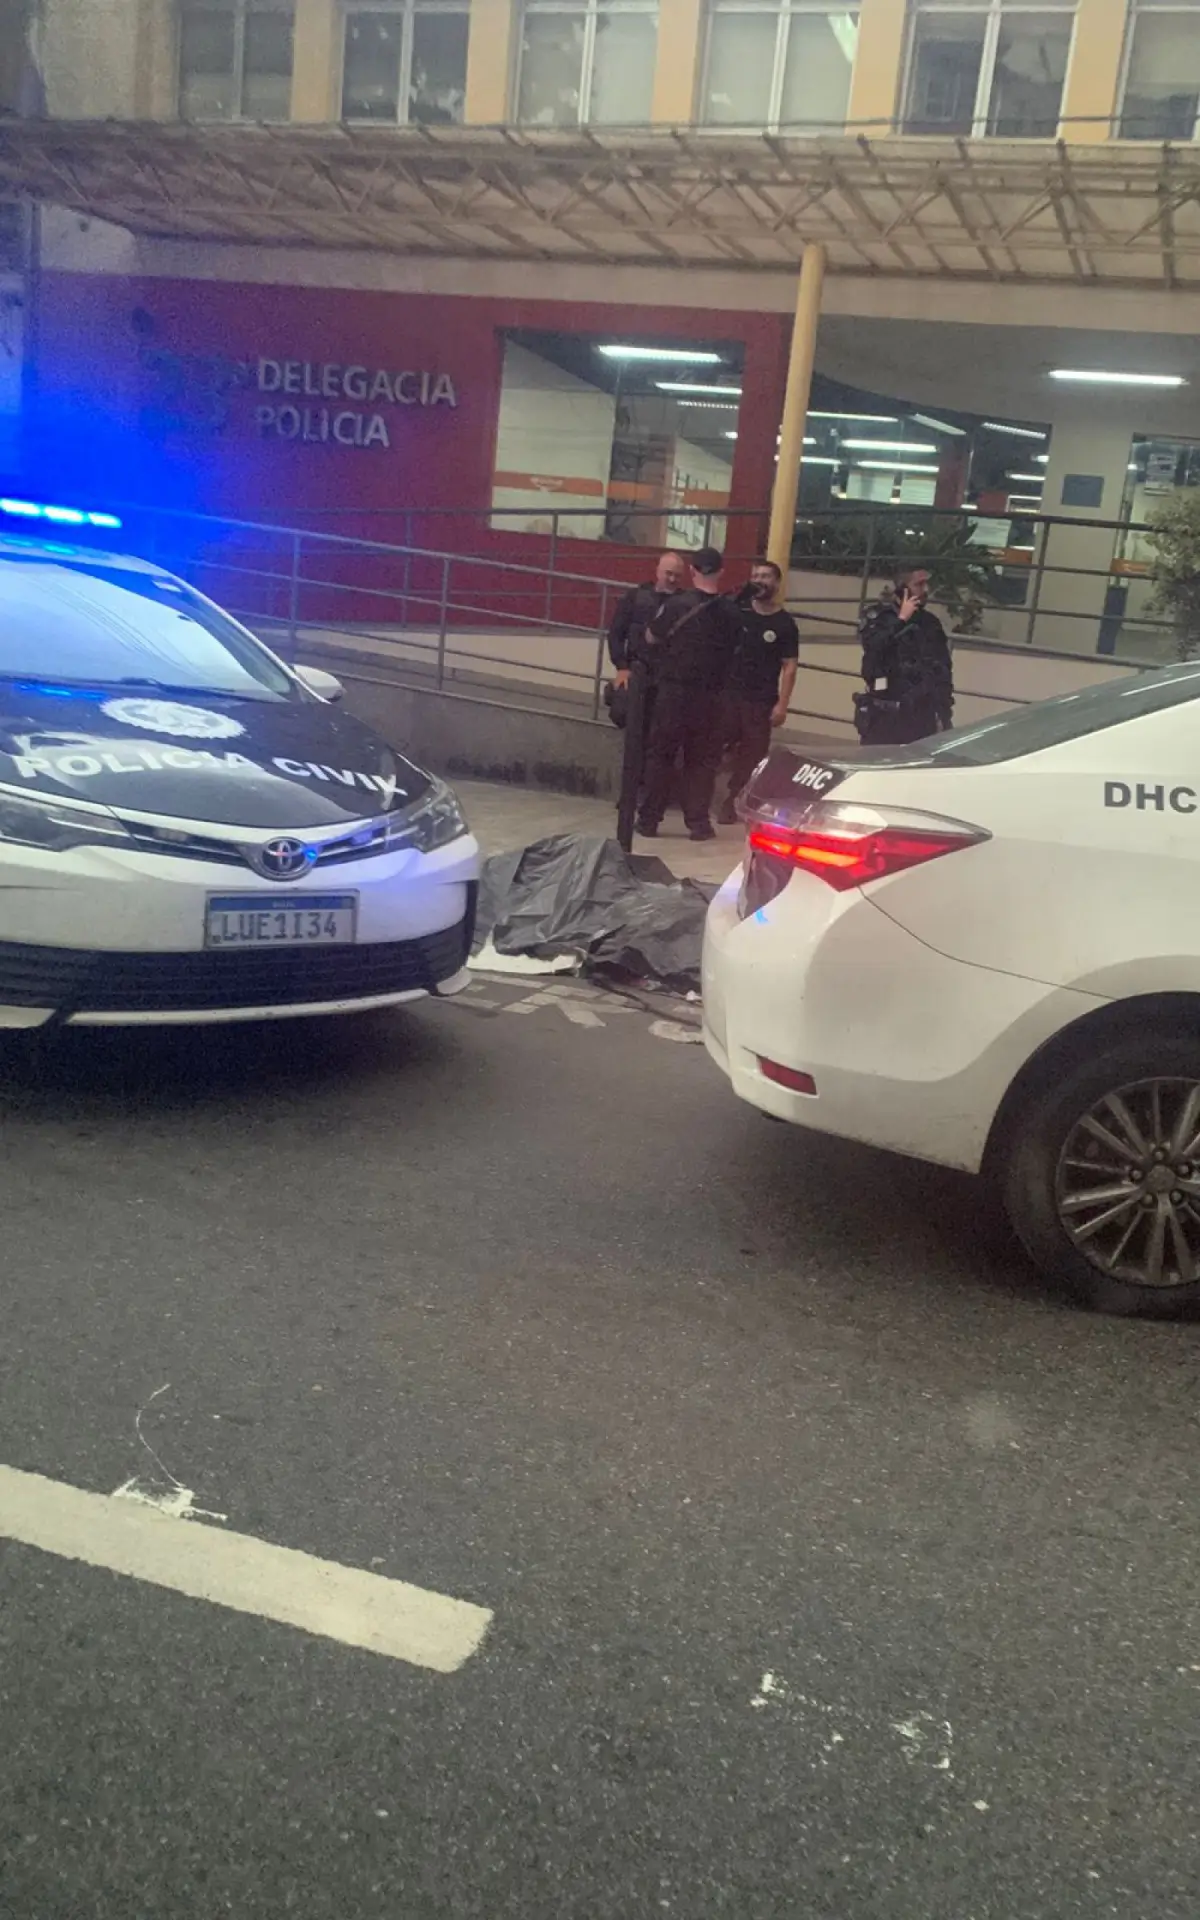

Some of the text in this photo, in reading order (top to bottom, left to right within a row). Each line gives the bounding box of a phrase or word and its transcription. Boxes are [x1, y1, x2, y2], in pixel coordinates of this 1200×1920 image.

[257, 358, 457, 407] DELEGACIA
[11, 750, 260, 779] POLICIA
[791, 763, 833, 791] DHC
[1104, 781, 1198, 813] DHC
